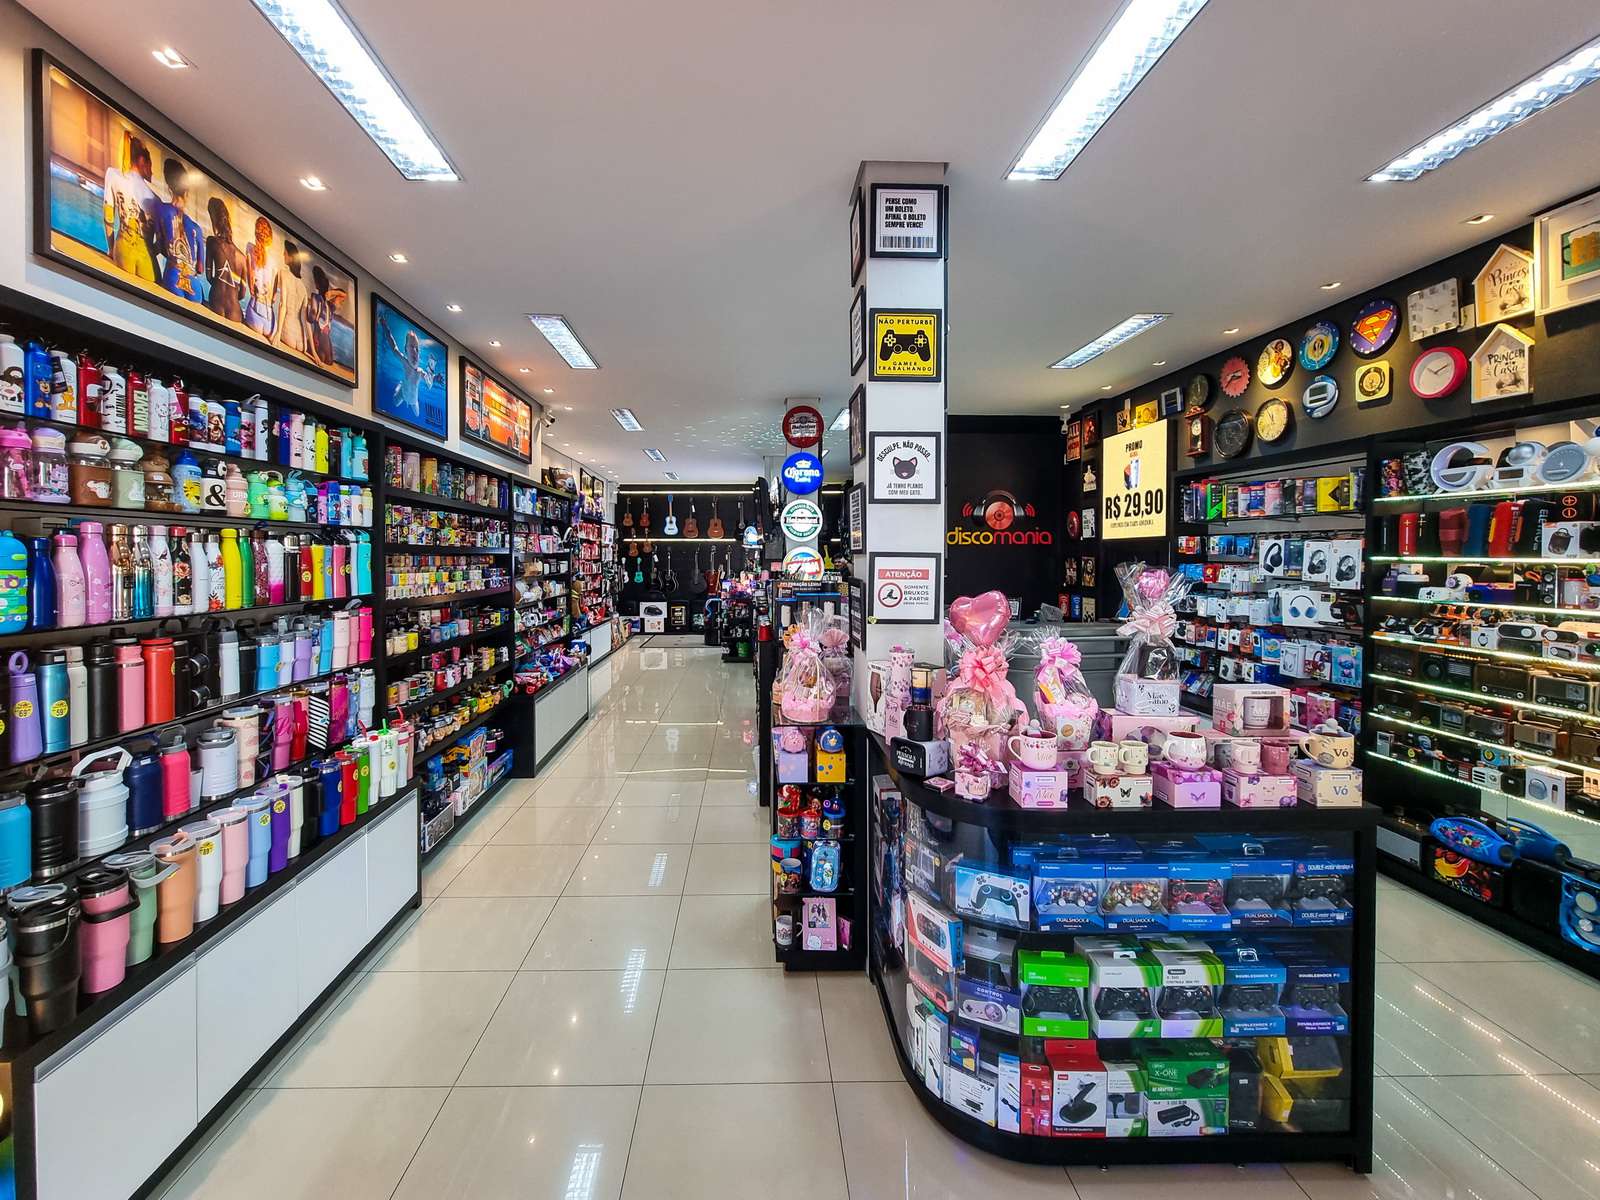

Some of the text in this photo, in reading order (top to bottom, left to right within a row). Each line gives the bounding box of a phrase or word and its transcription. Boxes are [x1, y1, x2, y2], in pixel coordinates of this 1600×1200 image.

[885, 197, 901, 205] PENSE
[133, 389, 149, 432] MARVEL
[902, 440, 914, 449] NÃO
[1125, 440, 1143, 454] PROMO
[784, 466, 821, 479] Corona
[1105, 488, 1163, 520] R$ 29,90
[946, 526, 1053, 545] discomania
[885, 570, 923, 579] ATENÇÃO
[1333, 748, 1349, 758] Vó
[1333, 785, 1349, 796] Vó
[976, 986, 1004, 998] CONTROL
[1154, 1069, 1177, 1077] X-ONE
